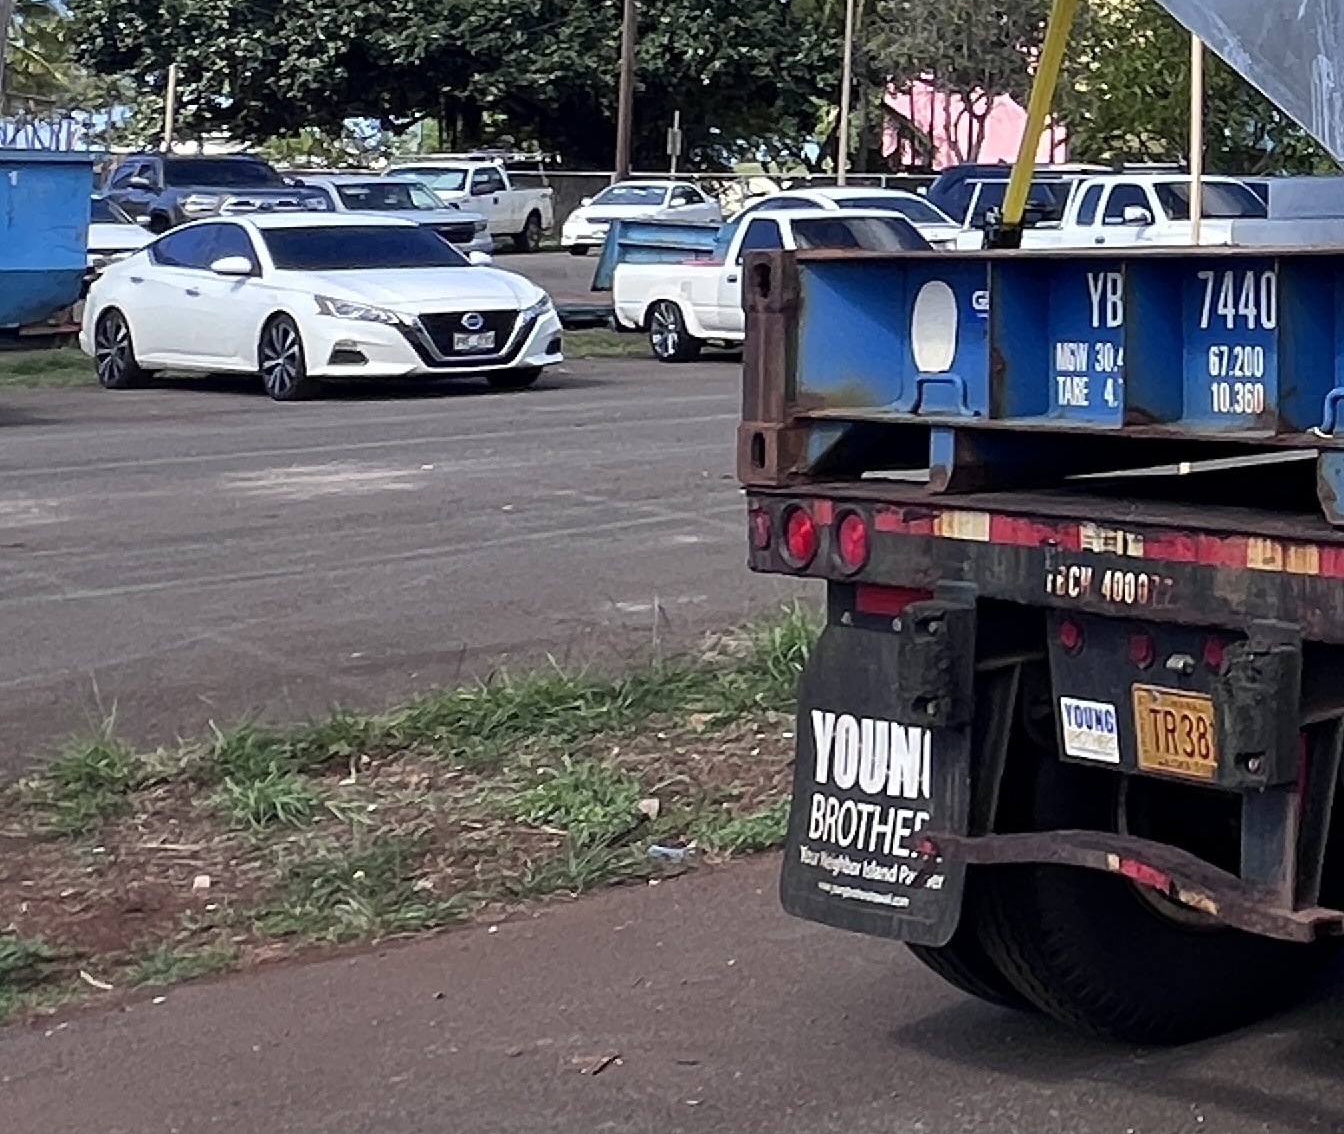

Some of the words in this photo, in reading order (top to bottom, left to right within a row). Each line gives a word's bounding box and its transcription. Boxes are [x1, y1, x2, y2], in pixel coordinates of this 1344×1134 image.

[1197, 270, 1276, 329] 7440
[1208, 346, 1264, 377] 67.200
[1056, 376, 1089, 406] TARE
[1210, 382, 1264, 414] 10.360
[1063, 702, 1115, 734] YOUNG
[1149, 708, 1211, 760] TR38
